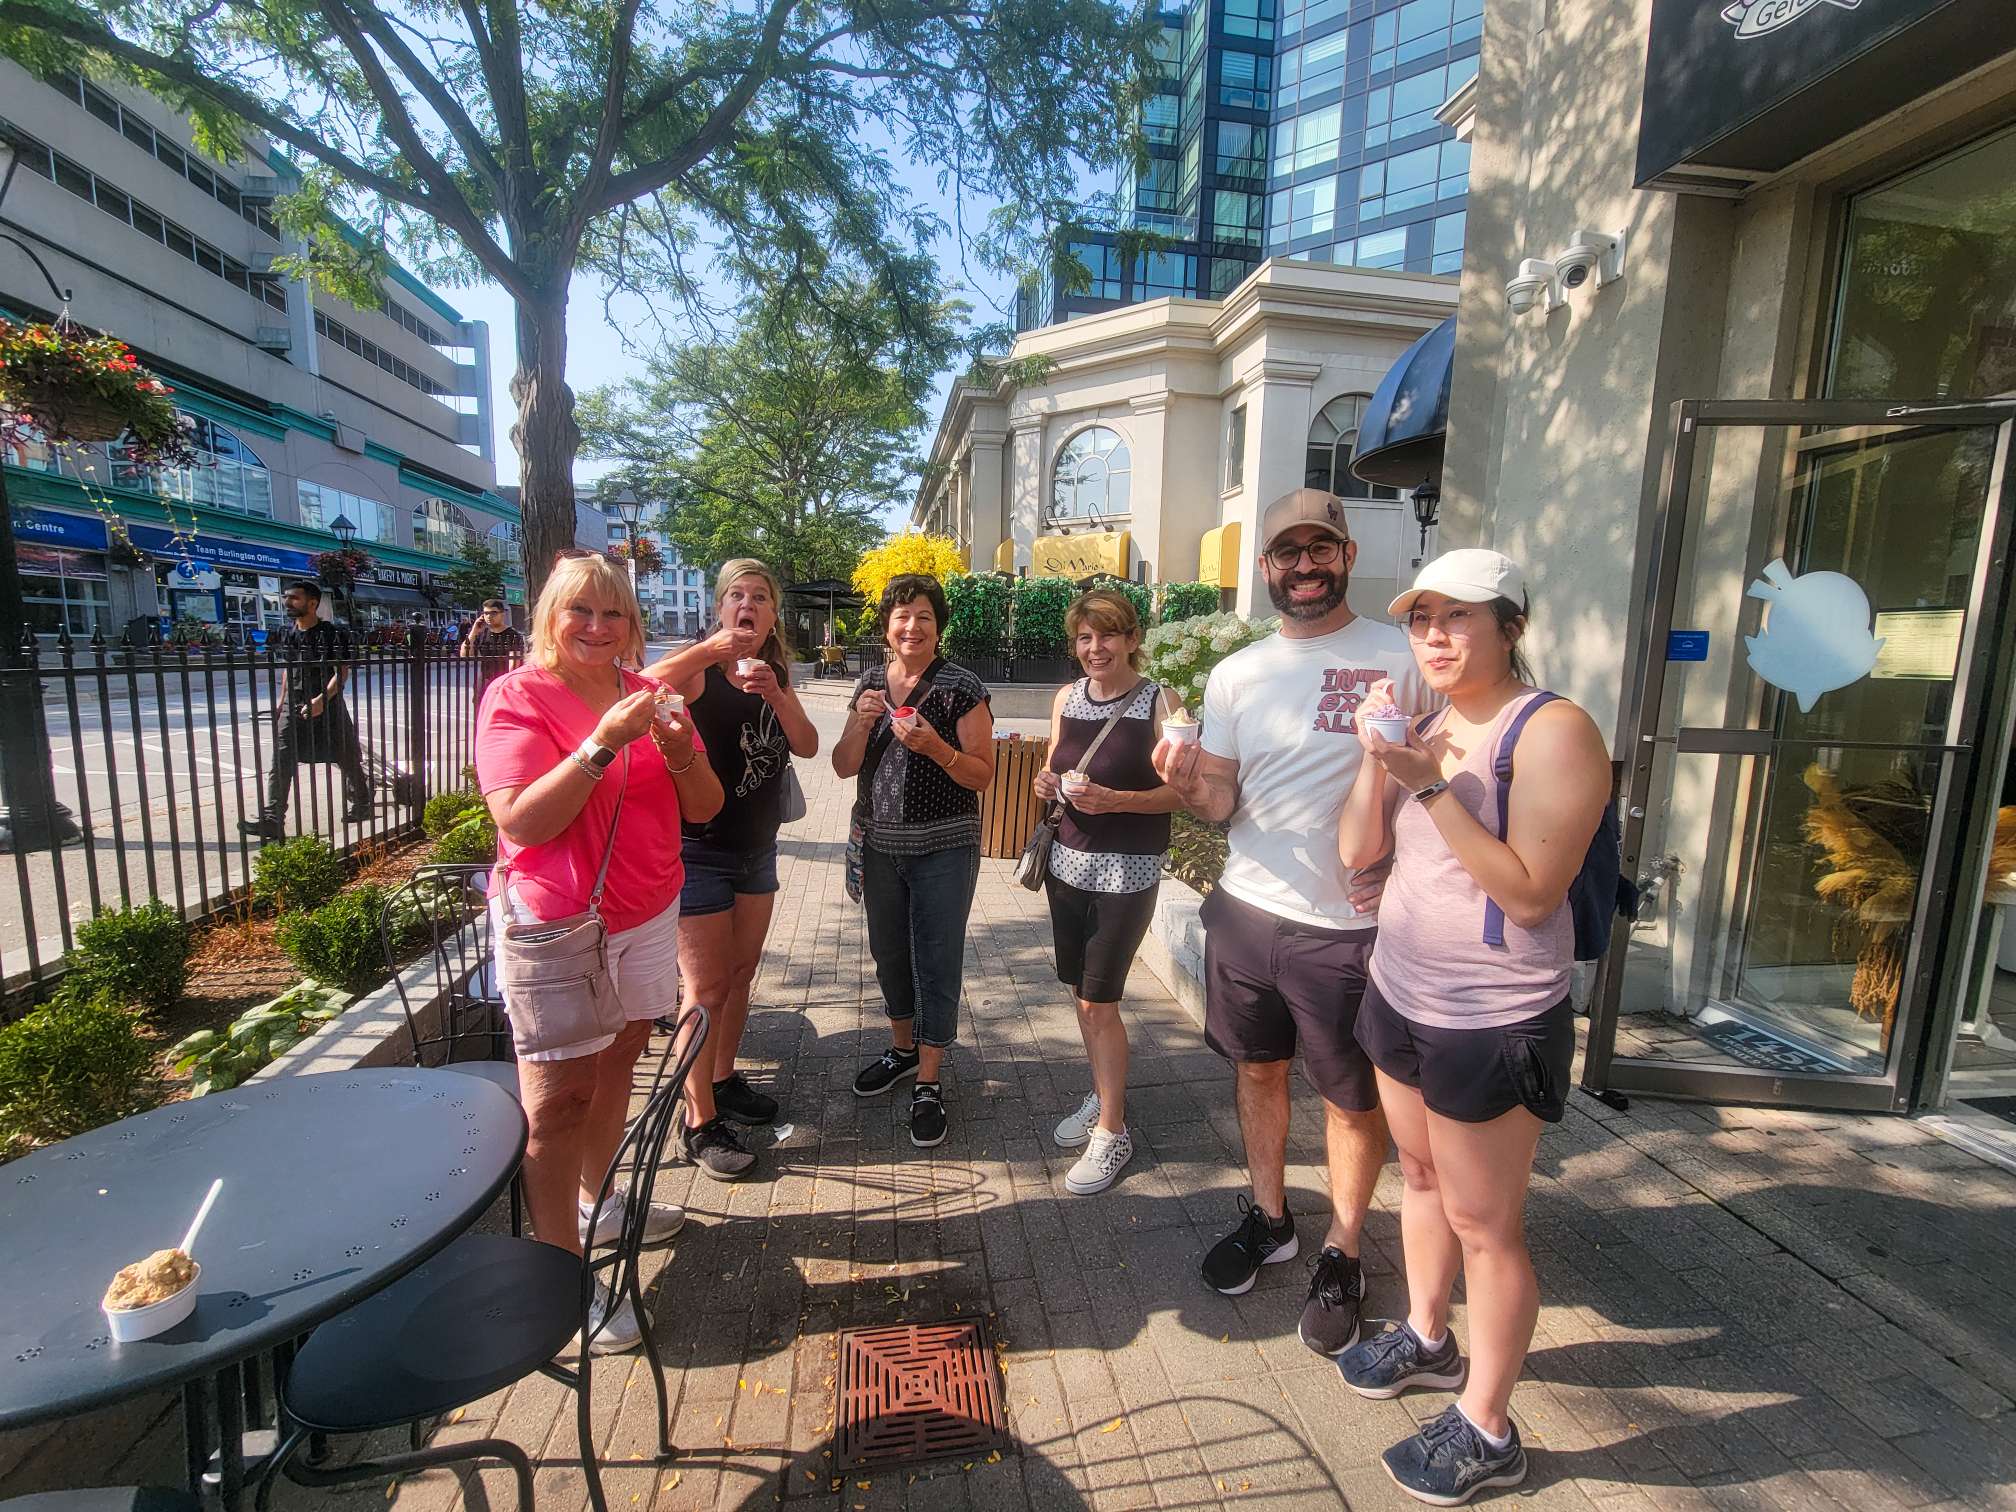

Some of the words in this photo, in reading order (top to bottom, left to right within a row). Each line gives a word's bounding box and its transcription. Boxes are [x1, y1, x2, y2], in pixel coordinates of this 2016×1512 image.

[25, 519, 65, 534] Centre
[194, 544, 217, 556] Team
[218, 548, 256, 562] Burlington
[257, 553, 280, 564] Offices
[377, 568, 395, 582] BAKERY
